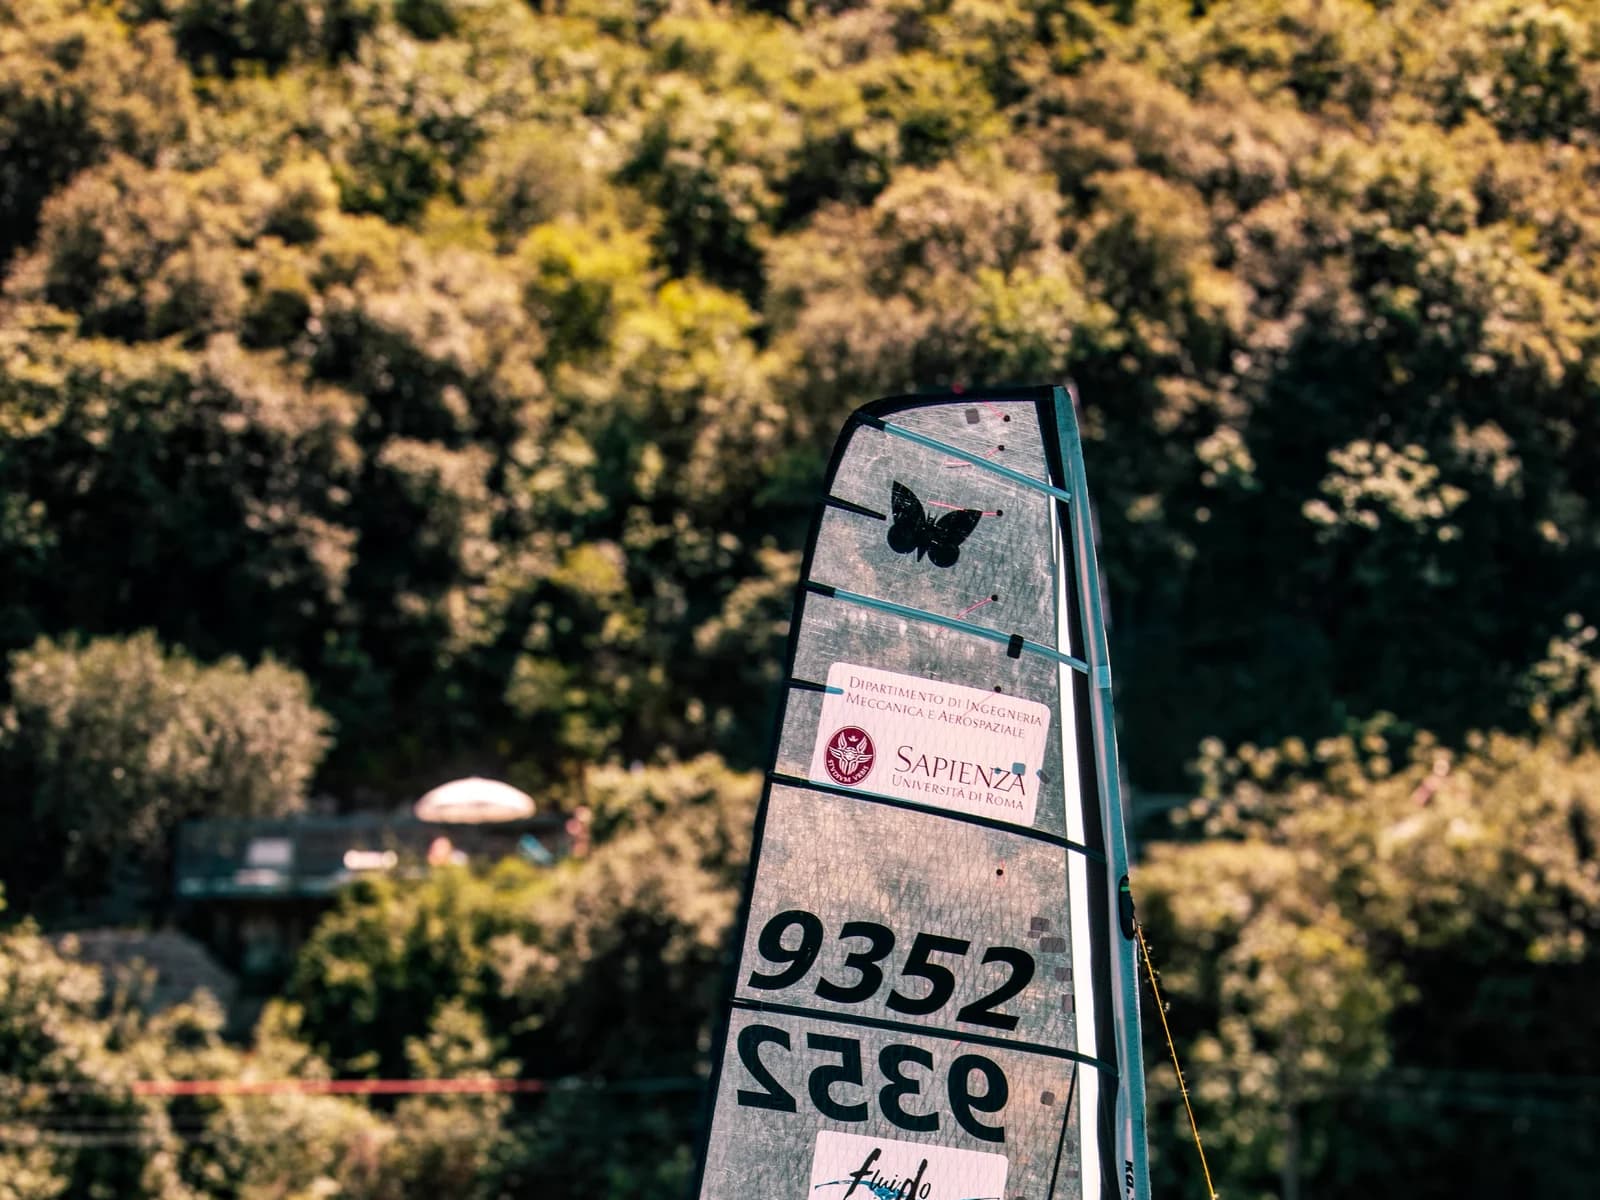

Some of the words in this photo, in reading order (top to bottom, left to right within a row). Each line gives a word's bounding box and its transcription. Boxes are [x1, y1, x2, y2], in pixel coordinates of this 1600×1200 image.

[846, 692, 924, 718] MECCANICA
[928, 710, 935, 719] E
[938, 710, 1025, 738] AEROSPAZIALE
[849, 676, 944, 705] DIPARTIMENTO
[948, 697, 962, 708] DI
[966, 699, 1042, 727] INGEGNERIA
[894, 745, 1026, 796] SAPIENZA
[968, 790, 982, 802] DI
[986, 793, 1024, 811] ROMA
[747, 910, 1036, 1032] 9352
